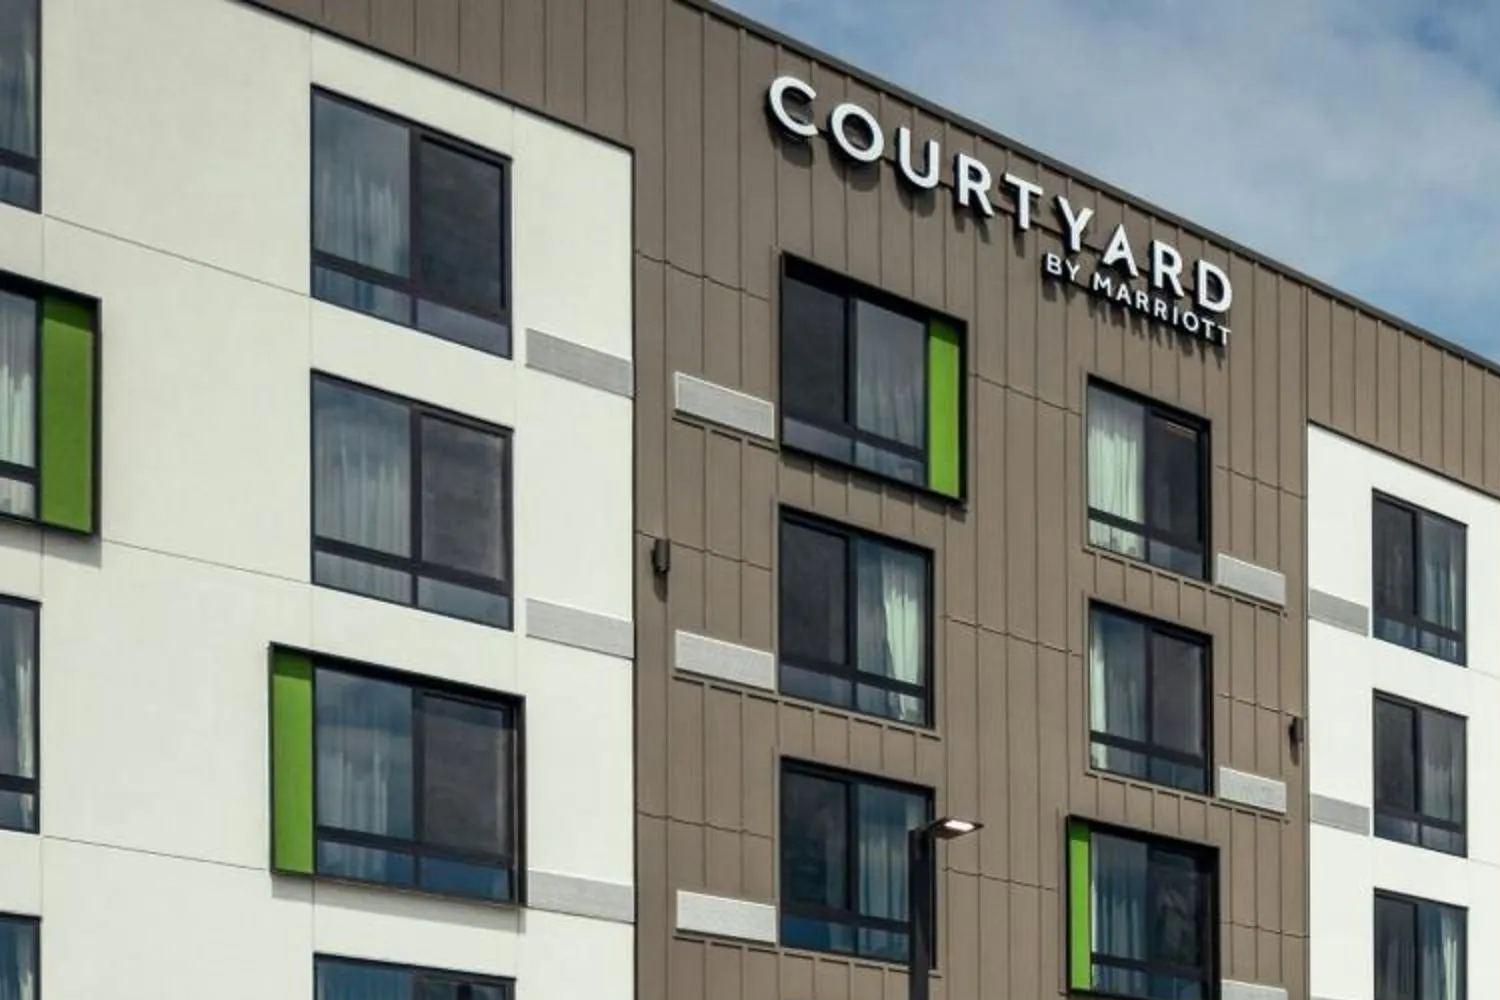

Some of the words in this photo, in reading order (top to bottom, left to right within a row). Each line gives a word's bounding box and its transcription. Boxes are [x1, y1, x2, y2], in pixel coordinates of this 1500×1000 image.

[769, 76, 1233, 313] COURTYARD
[1046, 252, 1079, 280] BY
[1093, 275, 1232, 345] MARRIOTT
